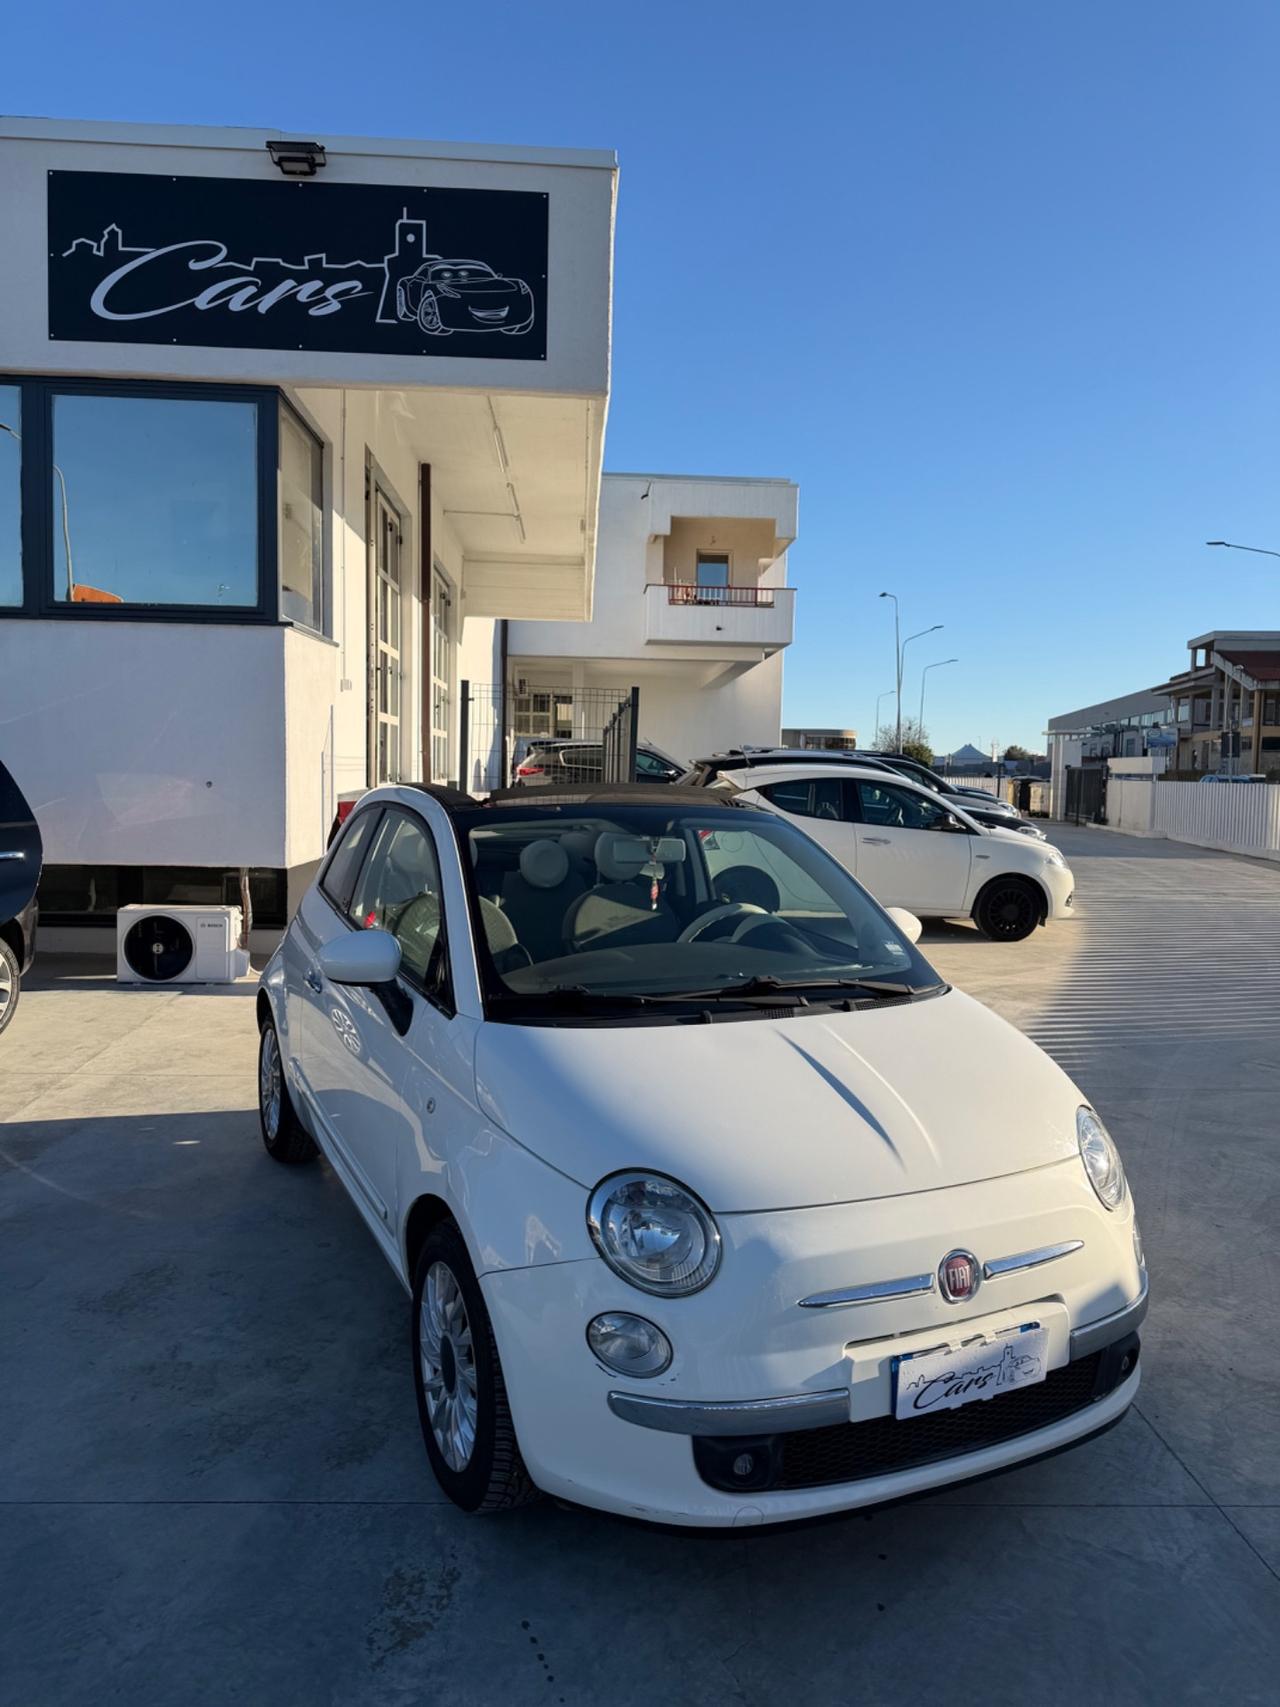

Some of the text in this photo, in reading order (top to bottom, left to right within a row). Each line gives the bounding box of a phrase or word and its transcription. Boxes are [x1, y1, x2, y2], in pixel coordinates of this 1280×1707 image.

[90, 240, 374, 320] Cars
[949, 1265, 970, 1290] FIAT
[913, 1371, 994, 1410] Cars
